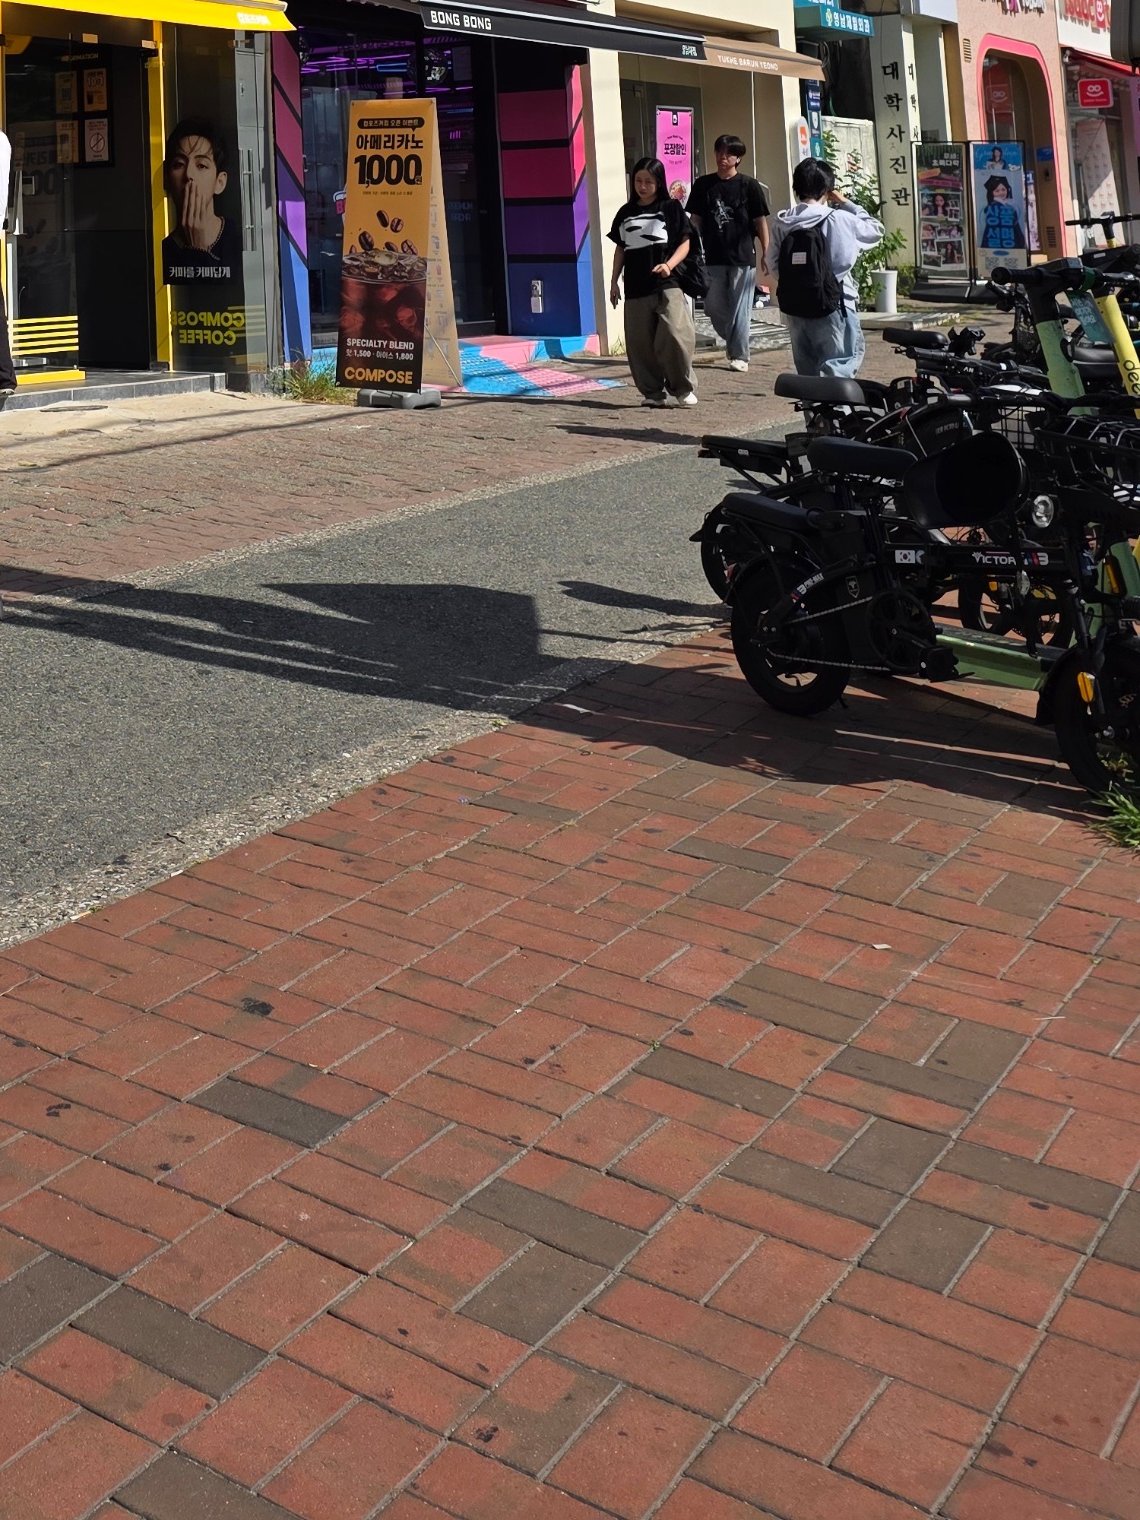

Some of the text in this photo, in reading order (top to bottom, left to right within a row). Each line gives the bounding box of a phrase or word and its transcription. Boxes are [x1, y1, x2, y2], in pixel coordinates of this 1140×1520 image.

[430, 10, 492, 31] BONG BONG
[834, 12, 870, 33] 영남제일외과
[356, 133, 424, 150] 아메리카노
[882, 61, 910, 206] 대학사진관
[664, 143, 687, 155] 포장할인
[986, 205, 1015, 225] 상품
[987, 228, 1016, 249] 설명
[346, 338, 414, 350] SPECIALTY BLEND
[376, 351, 393, 359] 아이스
[344, 366, 413, 384] COMPOSE
[972, 551, 1017, 566] VICTOR
